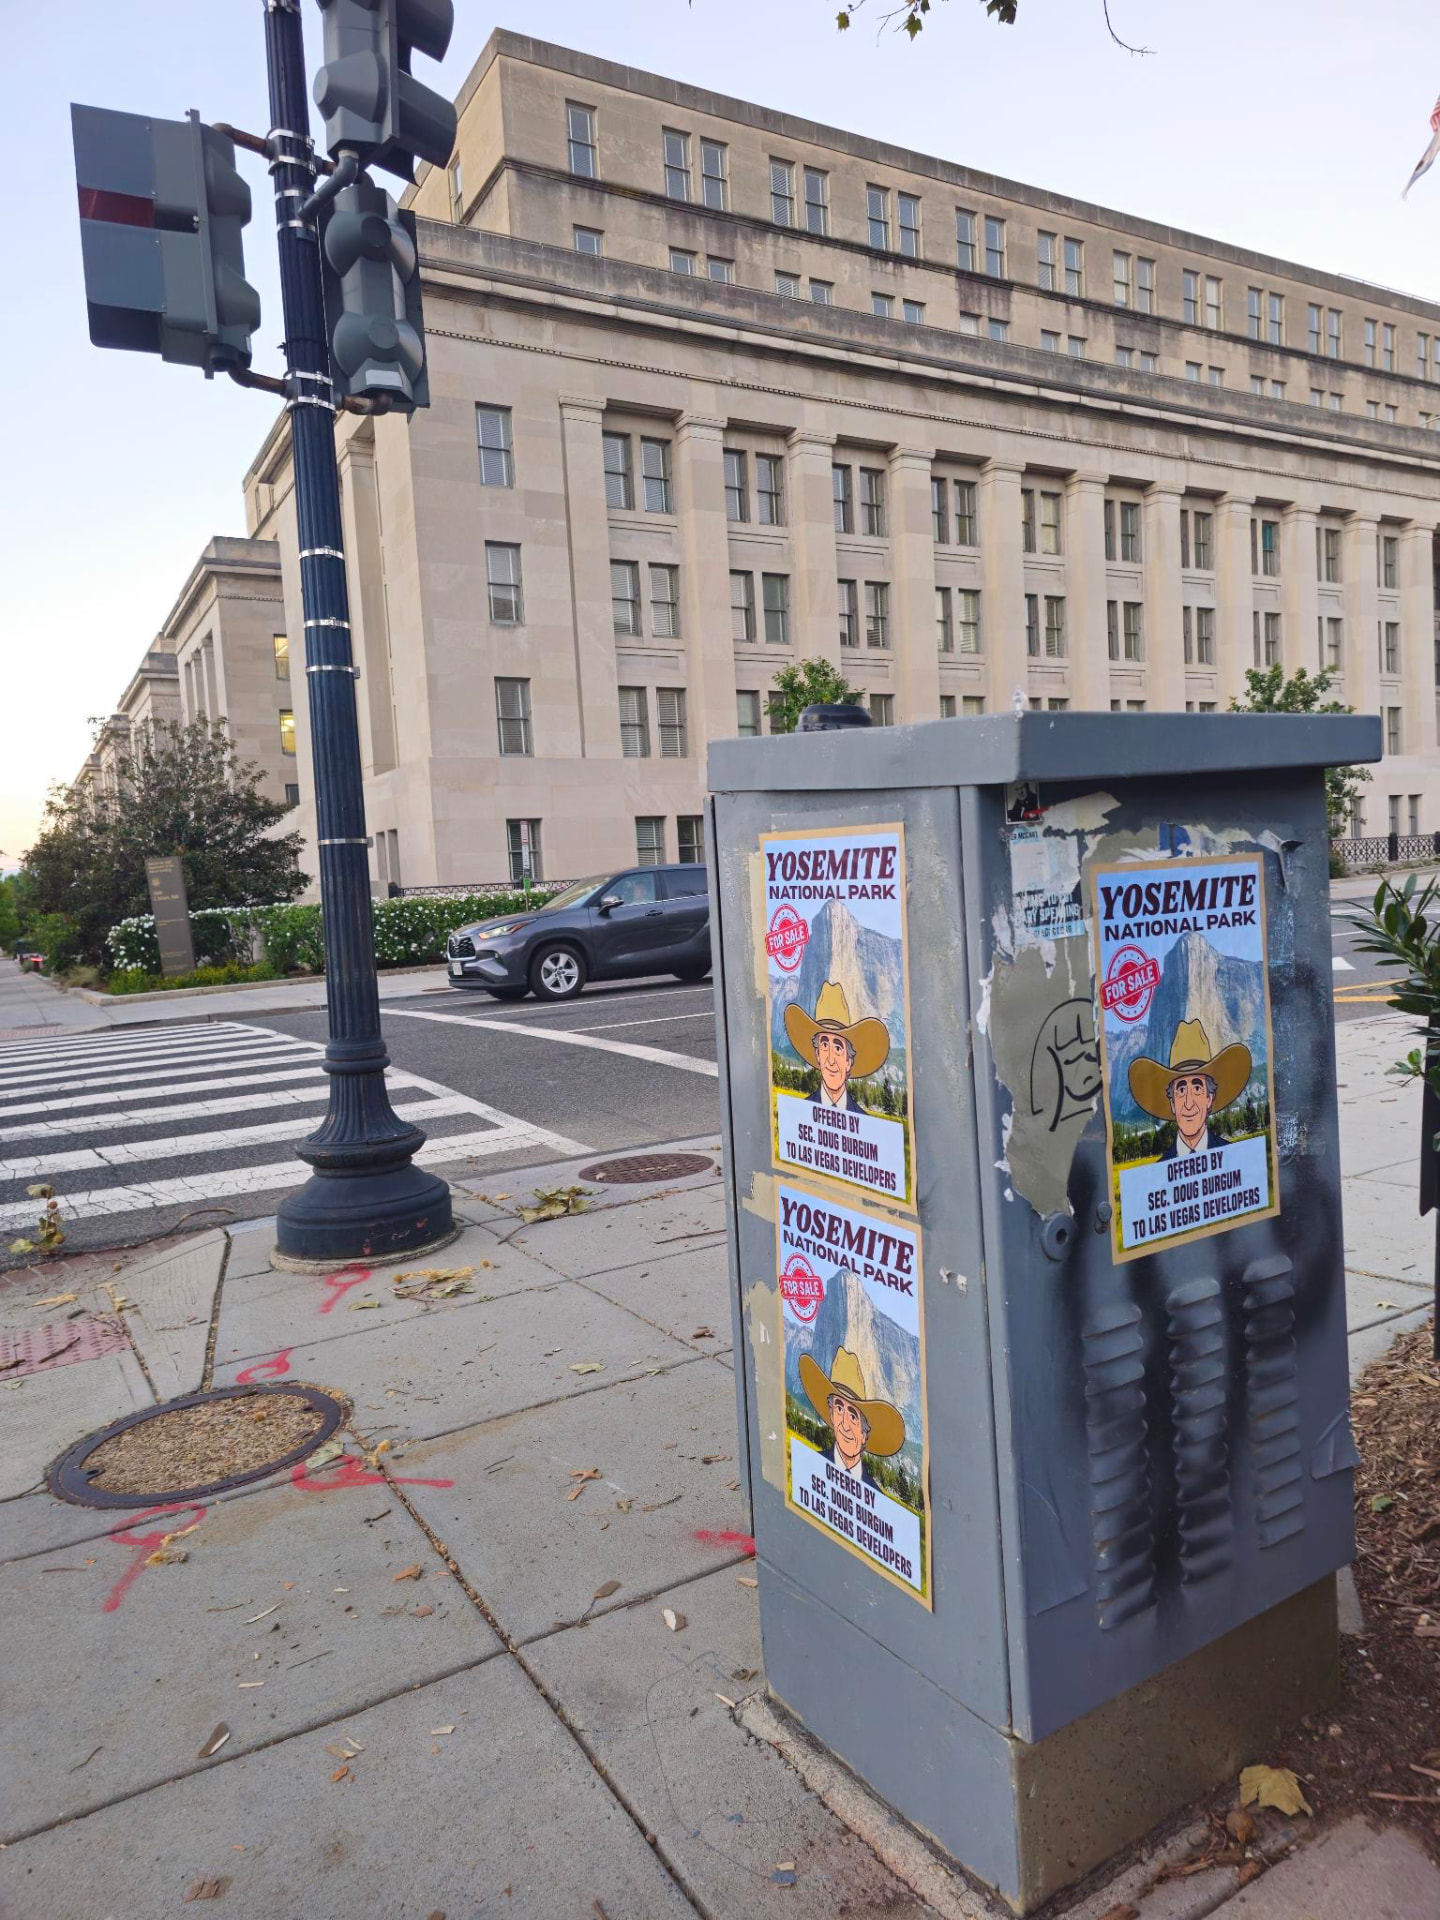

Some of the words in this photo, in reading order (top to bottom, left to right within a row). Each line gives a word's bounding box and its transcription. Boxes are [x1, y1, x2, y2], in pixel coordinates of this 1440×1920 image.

[766, 846, 896, 882] YOSEMITE
[769, 885, 845, 900] NATIONAL
[849, 884, 896, 900] PARK
[1100, 874, 1256, 920] YOSEMITE
[768, 934, 784, 949] FOR
[784, 925, 805, 945] SALE
[1105, 916, 1203, 941] NATIONAL
[1207, 910, 1256, 930] PARK
[1104, 980, 1125, 1003] FOR
[1127, 965, 1155, 993] SALE
[812, 1106, 847, 1131] OFFERED
[849, 1114, 860, 1134] BY
[798, 1123, 816, 1143] SEC.
[818, 1129, 839, 1151] DOUG
[841, 1135, 878, 1162] BURGUM
[786, 1141, 796, 1159] TO
[798, 1144, 812, 1164] LAS
[814, 1148, 840, 1173] VEGAS
[842, 1157, 896, 1191] DEVELOPERS
[1167, 1154, 1207, 1182] OFFERED
[1210, 1151, 1223, 1170] BY
[1147, 1189, 1170, 1211] SEC.
[1173, 1180, 1199, 1204] DOUG
[1202, 1169, 1242, 1196] BURGUM
[1132, 1218, 1146, 1240] TO
[1149, 1213, 1167, 1235] LAS
[1169, 1205, 1200, 1229] VEGAS
[1203, 1187, 1260, 1220] DEVELOPERS
[780, 1196, 914, 1275] YOSEMITE
[783, 1230, 861, 1275] NATIONAL
[864, 1263, 914, 1297] PARK
[783, 1281, 799, 1295] FOR
[800, 1281, 820, 1296] SALE
[825, 1462, 862, 1500] OFFERED
[864, 1486, 875, 1508] BY
[811, 1474, 829, 1500] SEC.
[831, 1487, 853, 1516] DOUG
[856, 1504, 894, 1543] BURGUM
[799, 1486, 809, 1507] TO
[811, 1495, 826, 1518] LAS
[828, 1505, 854, 1538] VEGAS
[856, 1525, 912, 1579] DEVELOPERS
